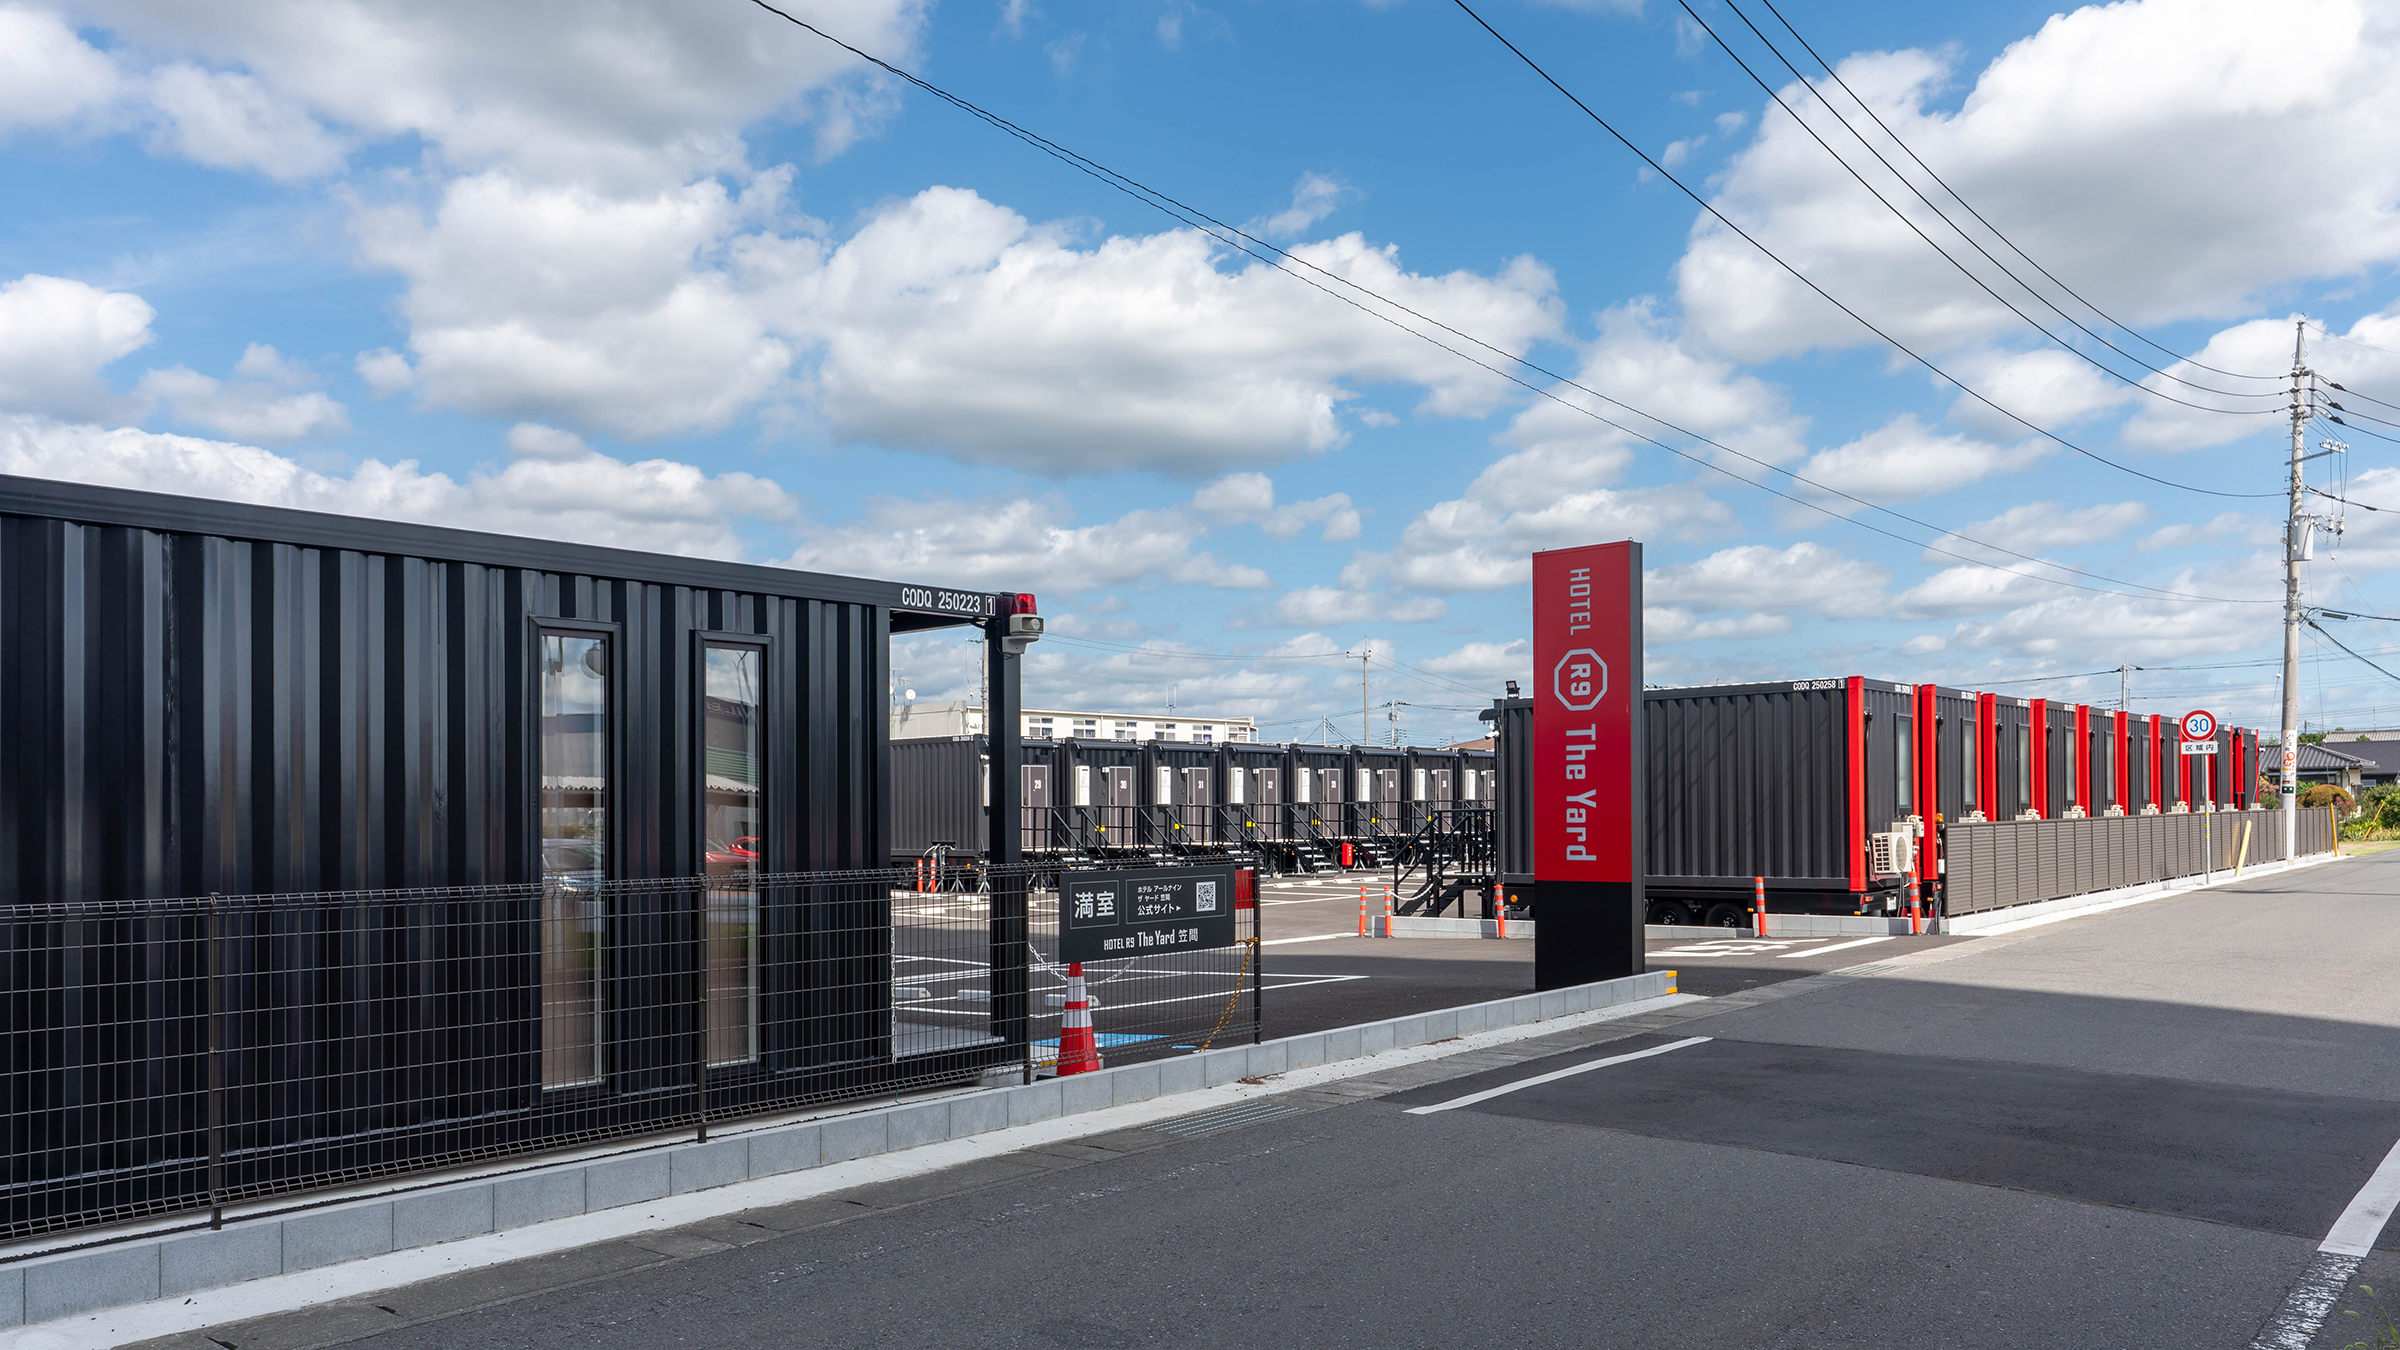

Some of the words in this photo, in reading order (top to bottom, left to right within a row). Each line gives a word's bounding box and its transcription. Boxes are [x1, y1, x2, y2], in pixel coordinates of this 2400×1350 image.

[902, 587, 932, 608] CODQ
[938, 591, 980, 613] 250223
[987, 596, 994, 615] 1
[1570, 567, 1591, 635] HOTEL
[1570, 663, 1591, 696] R9
[1812, 681, 1836, 689] 250258
[2190, 718, 2209, 732] 30
[1566, 723, 1596, 780] The
[1034, 779, 1041, 789] 29
[1566, 789, 1597, 861] Yard
[1137, 885, 1152, 893] ホテル
[1154, 884, 1182, 892] アールナイン
[1145, 894, 1159, 902] ヤード
[1074, 891, 1115, 919] 満室
[1137, 903, 1175, 916] 公式サイト
[1104, 938, 1124, 950] HOTEL
[1126, 937, 1134, 948] R9
[1137, 931, 1153, 947] The
[1155, 928, 1175, 945] Yard
[1178, 928, 1198, 943] 笠間
